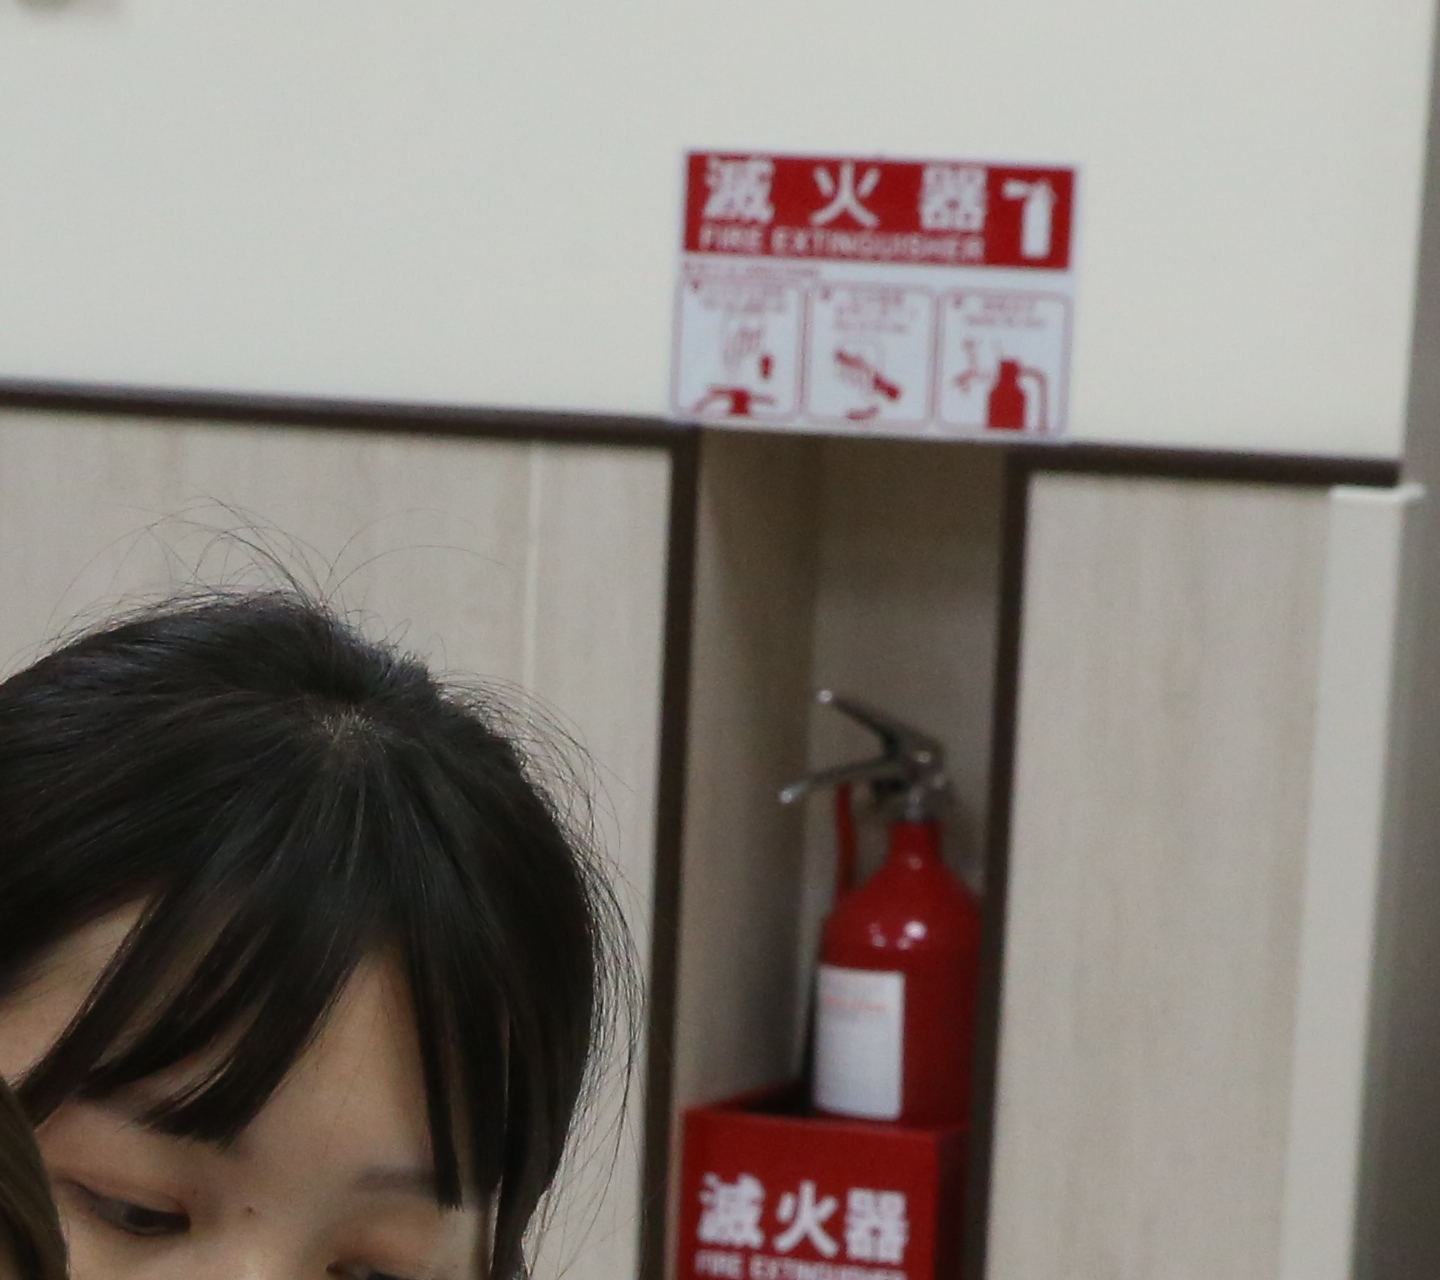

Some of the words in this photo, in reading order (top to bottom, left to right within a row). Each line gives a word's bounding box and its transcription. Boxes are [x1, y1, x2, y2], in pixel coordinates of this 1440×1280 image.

[702, 157, 990, 233] 滅火器
[698, 224, 763, 255] FIRE
[770, 226, 987, 263] EXTINGUISHER
[697, 1173, 910, 1265] 滅火器
[694, 1248, 742, 1280] FIRE
